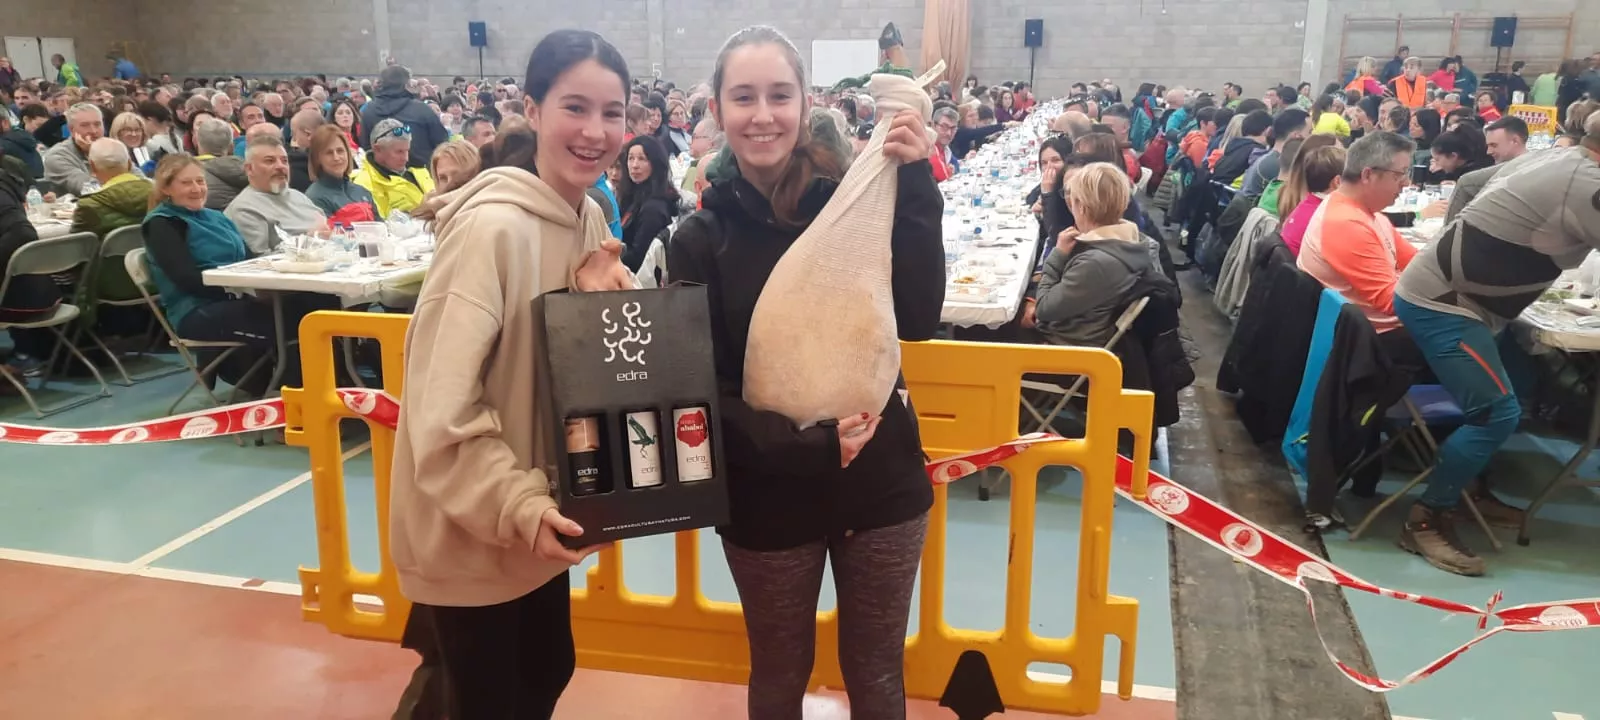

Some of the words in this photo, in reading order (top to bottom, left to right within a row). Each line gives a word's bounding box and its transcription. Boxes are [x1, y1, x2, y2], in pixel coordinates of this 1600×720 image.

[652, 63, 662, 79] 5
[616, 369, 648, 382] edra
[686, 454, 706, 464] edra
[577, 467, 599, 477] edra
